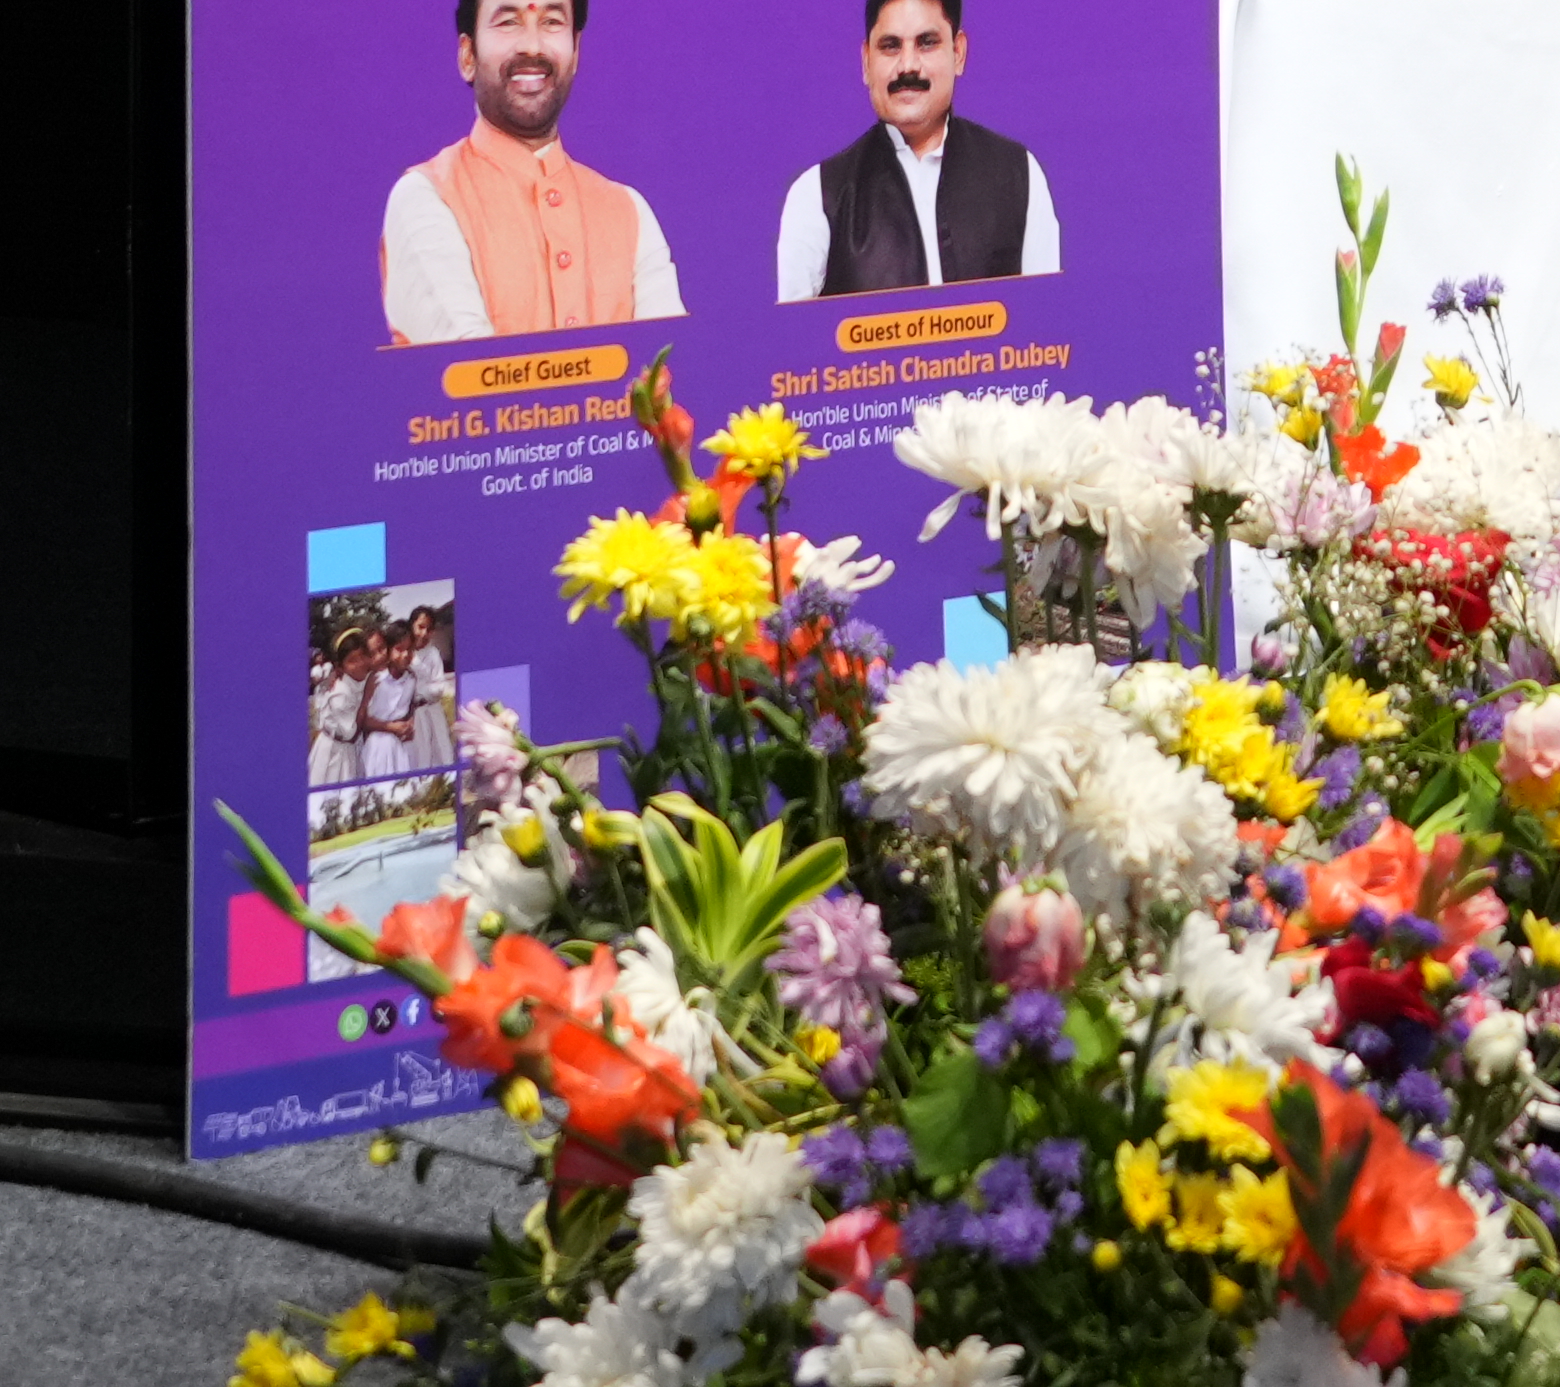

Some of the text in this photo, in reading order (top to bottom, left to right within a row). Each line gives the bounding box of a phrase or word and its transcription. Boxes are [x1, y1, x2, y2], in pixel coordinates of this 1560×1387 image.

[849, 312, 994, 345] Guest of Honour
[481, 354, 592, 387] Chief Guest
[770, 342, 1070, 399] Shri Satish Chandra Dubey
[408, 391, 631, 445] Shri G. Kishan Red
[792, 406, 850, 428] Hon'ble
[853, 400, 898, 422] Union
[1032, 378, 1049, 400] of
[374, 456, 439, 482] Hon'ble
[442, 450, 491, 474] Union
[495, 441, 563, 466] Minister
[566, 436, 585, 458] of
[588, 432, 622, 455] Coal
[626, 430, 640, 450] &
[822, 429, 855, 451] Coal
[859, 427, 871, 447] &
[481, 464, 593, 496] Govt. of India
